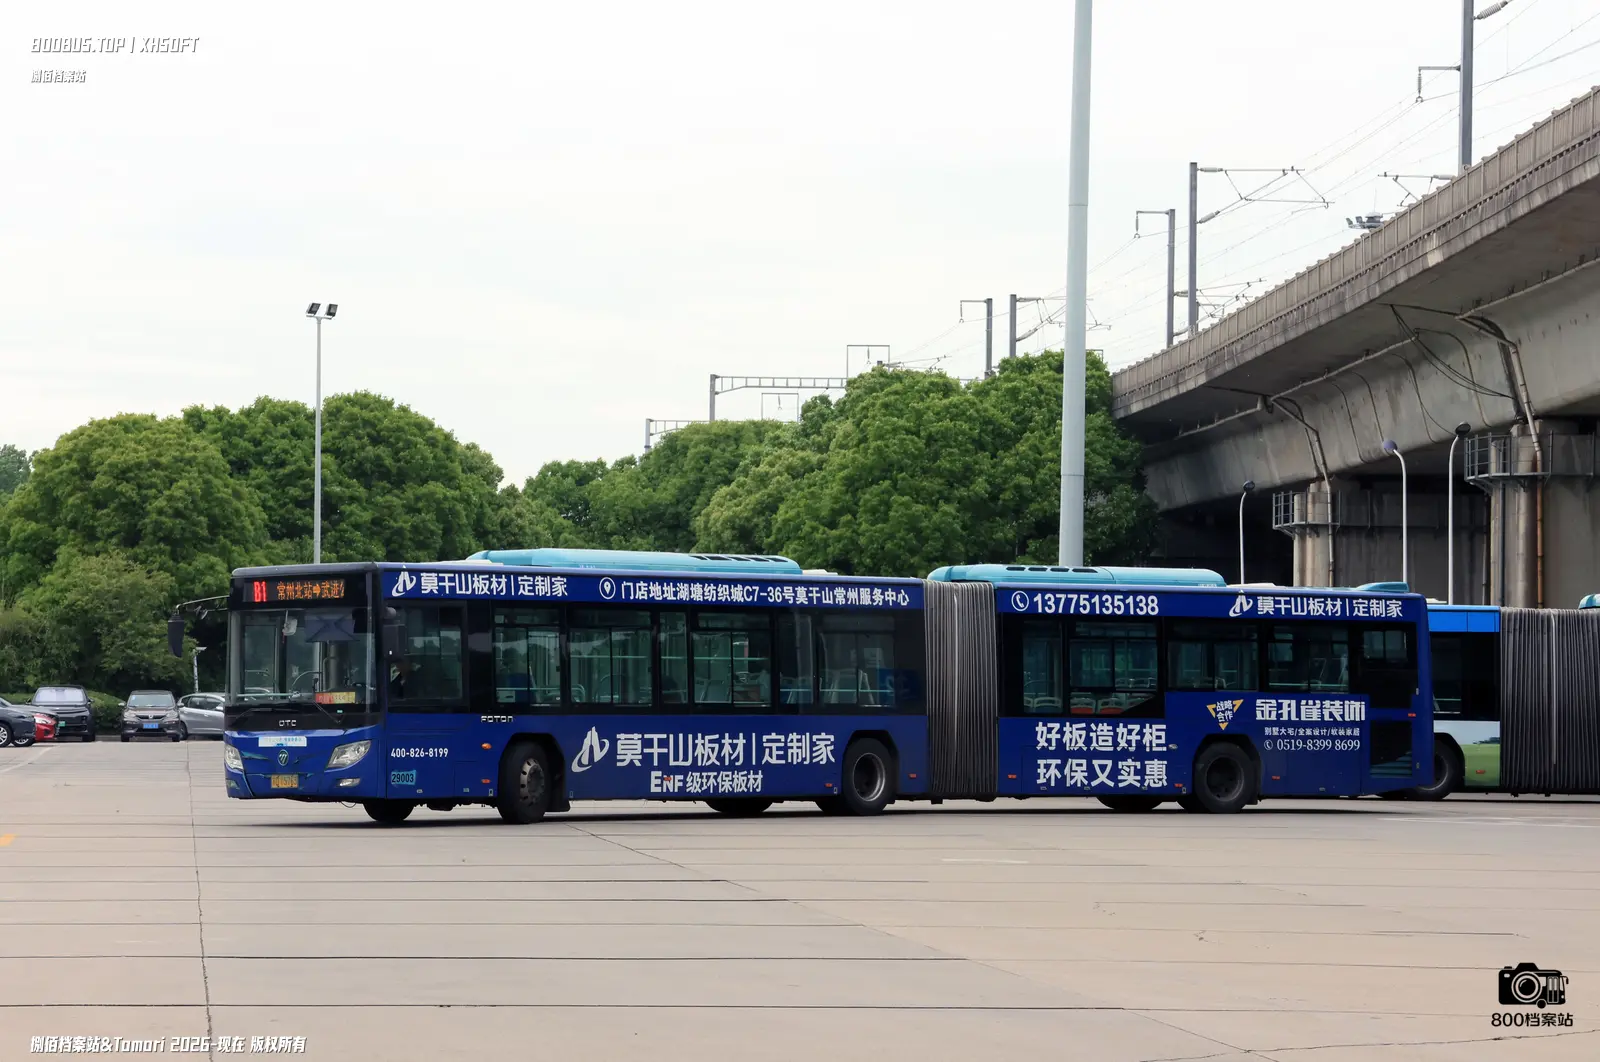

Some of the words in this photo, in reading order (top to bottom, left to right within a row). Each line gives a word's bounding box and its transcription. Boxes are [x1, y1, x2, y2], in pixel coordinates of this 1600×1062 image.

[253, 581, 267, 602] B1
[621, 581, 909, 606] 门店地址湖塘纺织城C7-36号莫干山常州服务中心
[1033, 592, 1159, 615] 13775135138
[1216, 700, 1233, 711] 战略
[1216, 711, 1233, 722] 合作
[1255, 698, 1366, 722] 金孔雀装饰
[1035, 721, 1168, 752] 好板造好柜
[1277, 739, 1332, 751] 0519-8399
[1334, 740, 1360, 751] 8699
[390, 747, 449, 758] 400-826-8199
[391, 773, 414, 783] 29003
[685, 770, 763, 794] 级环保板材
[1036, 758, 1168, 788] 环保又实惠
